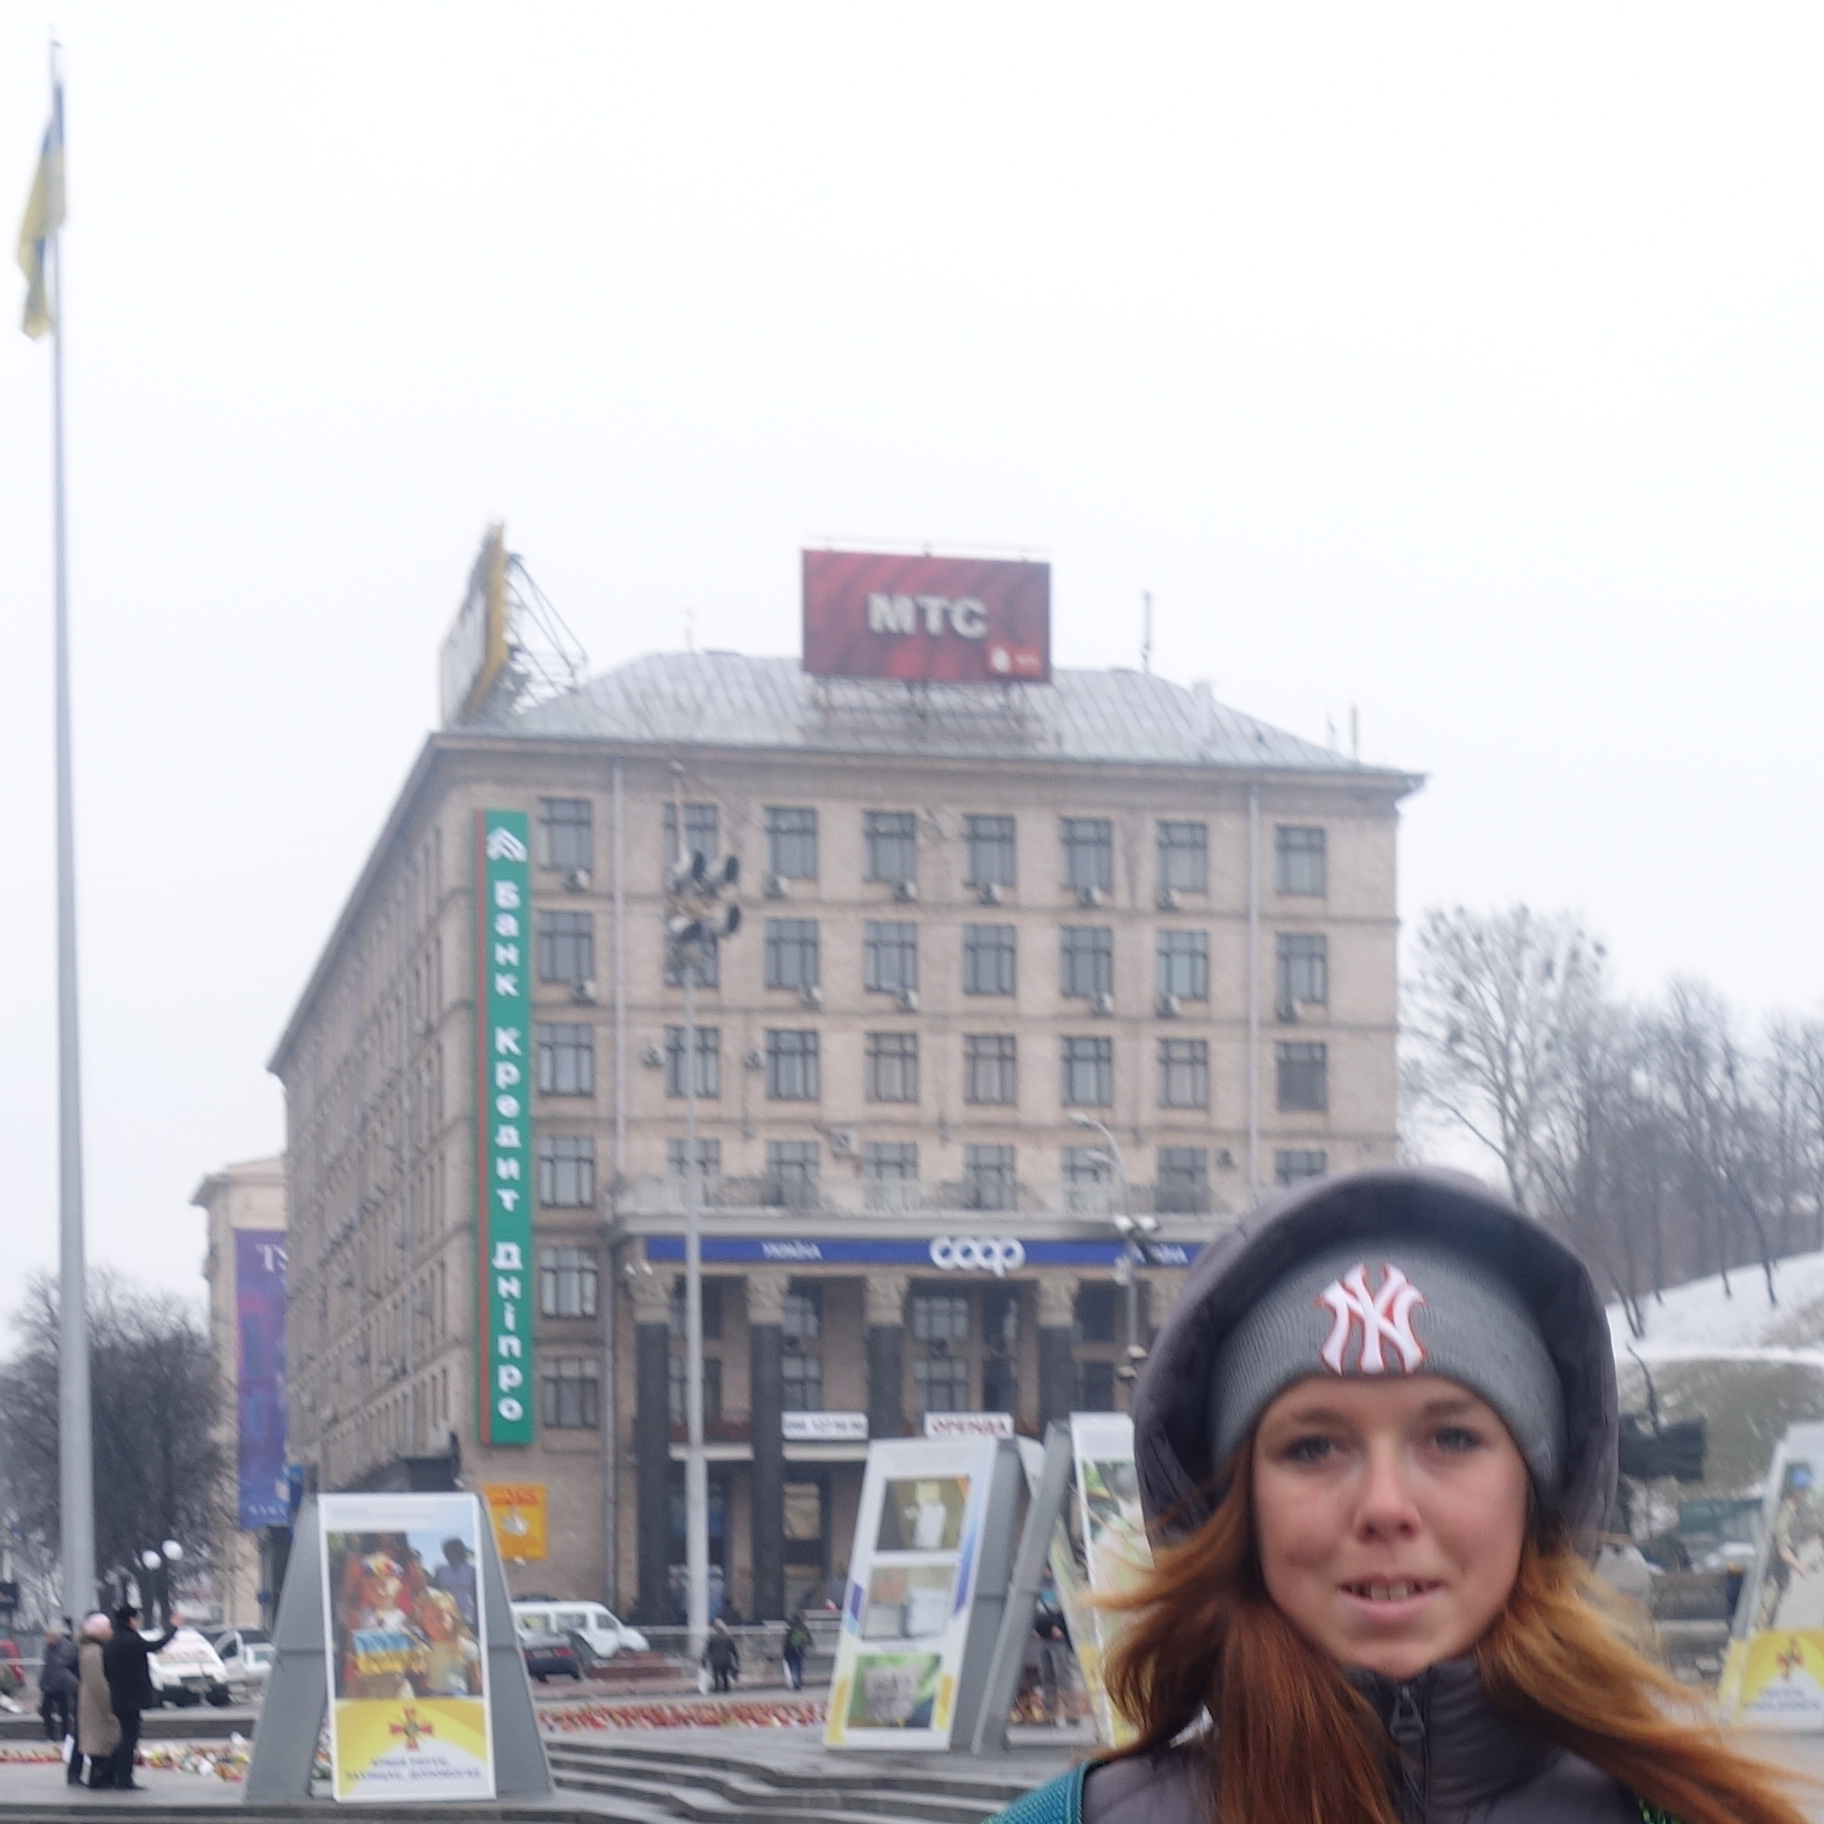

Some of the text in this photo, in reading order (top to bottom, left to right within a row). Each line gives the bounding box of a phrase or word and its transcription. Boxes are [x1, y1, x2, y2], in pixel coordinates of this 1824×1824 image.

[867, 592, 988, 639] МТС
[492, 879, 524, 1422] Банк Кредит Дніпро
[1315, 1262, 1429, 1377] NY
